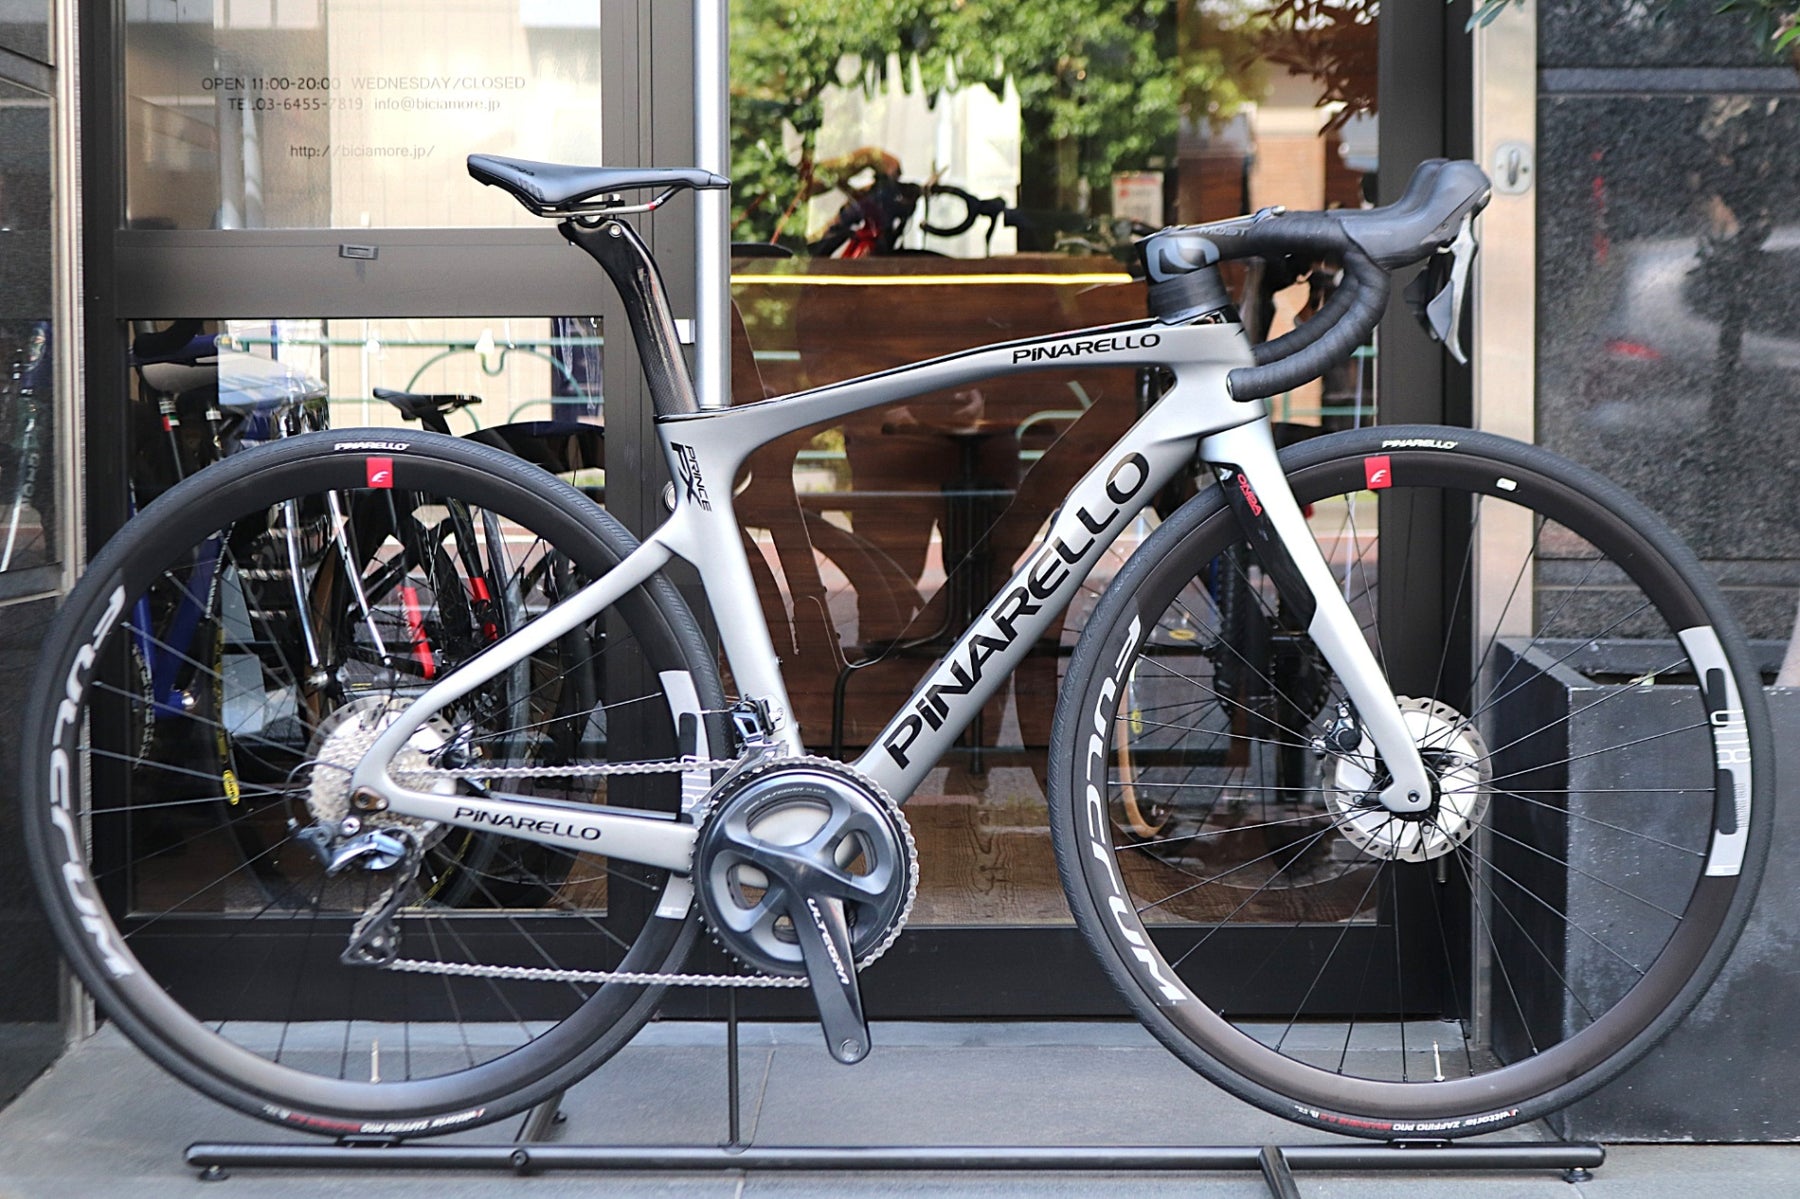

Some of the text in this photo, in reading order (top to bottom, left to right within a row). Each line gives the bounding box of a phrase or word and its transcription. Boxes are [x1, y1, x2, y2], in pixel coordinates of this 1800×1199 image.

[202, 77, 526, 90] OPEN 11:00-20:00 WEDNESDAY/CLOSED
[374, 96, 501, 112] info@biciamore.jp
[290, 144, 435, 160] http://biciamore.jp/
[1013, 334, 1161, 364] PINARELLO
[1382, 439, 1458, 450] PINARELLO
[685, 444, 712, 512] PRINCE
[882, 452, 1149, 770] PINARELLO
[454, 807, 602, 841] PINARELLO
[1393, 1122, 1415, 1131] PRO
[1416, 1120, 1461, 1131] ZAFFIRO
